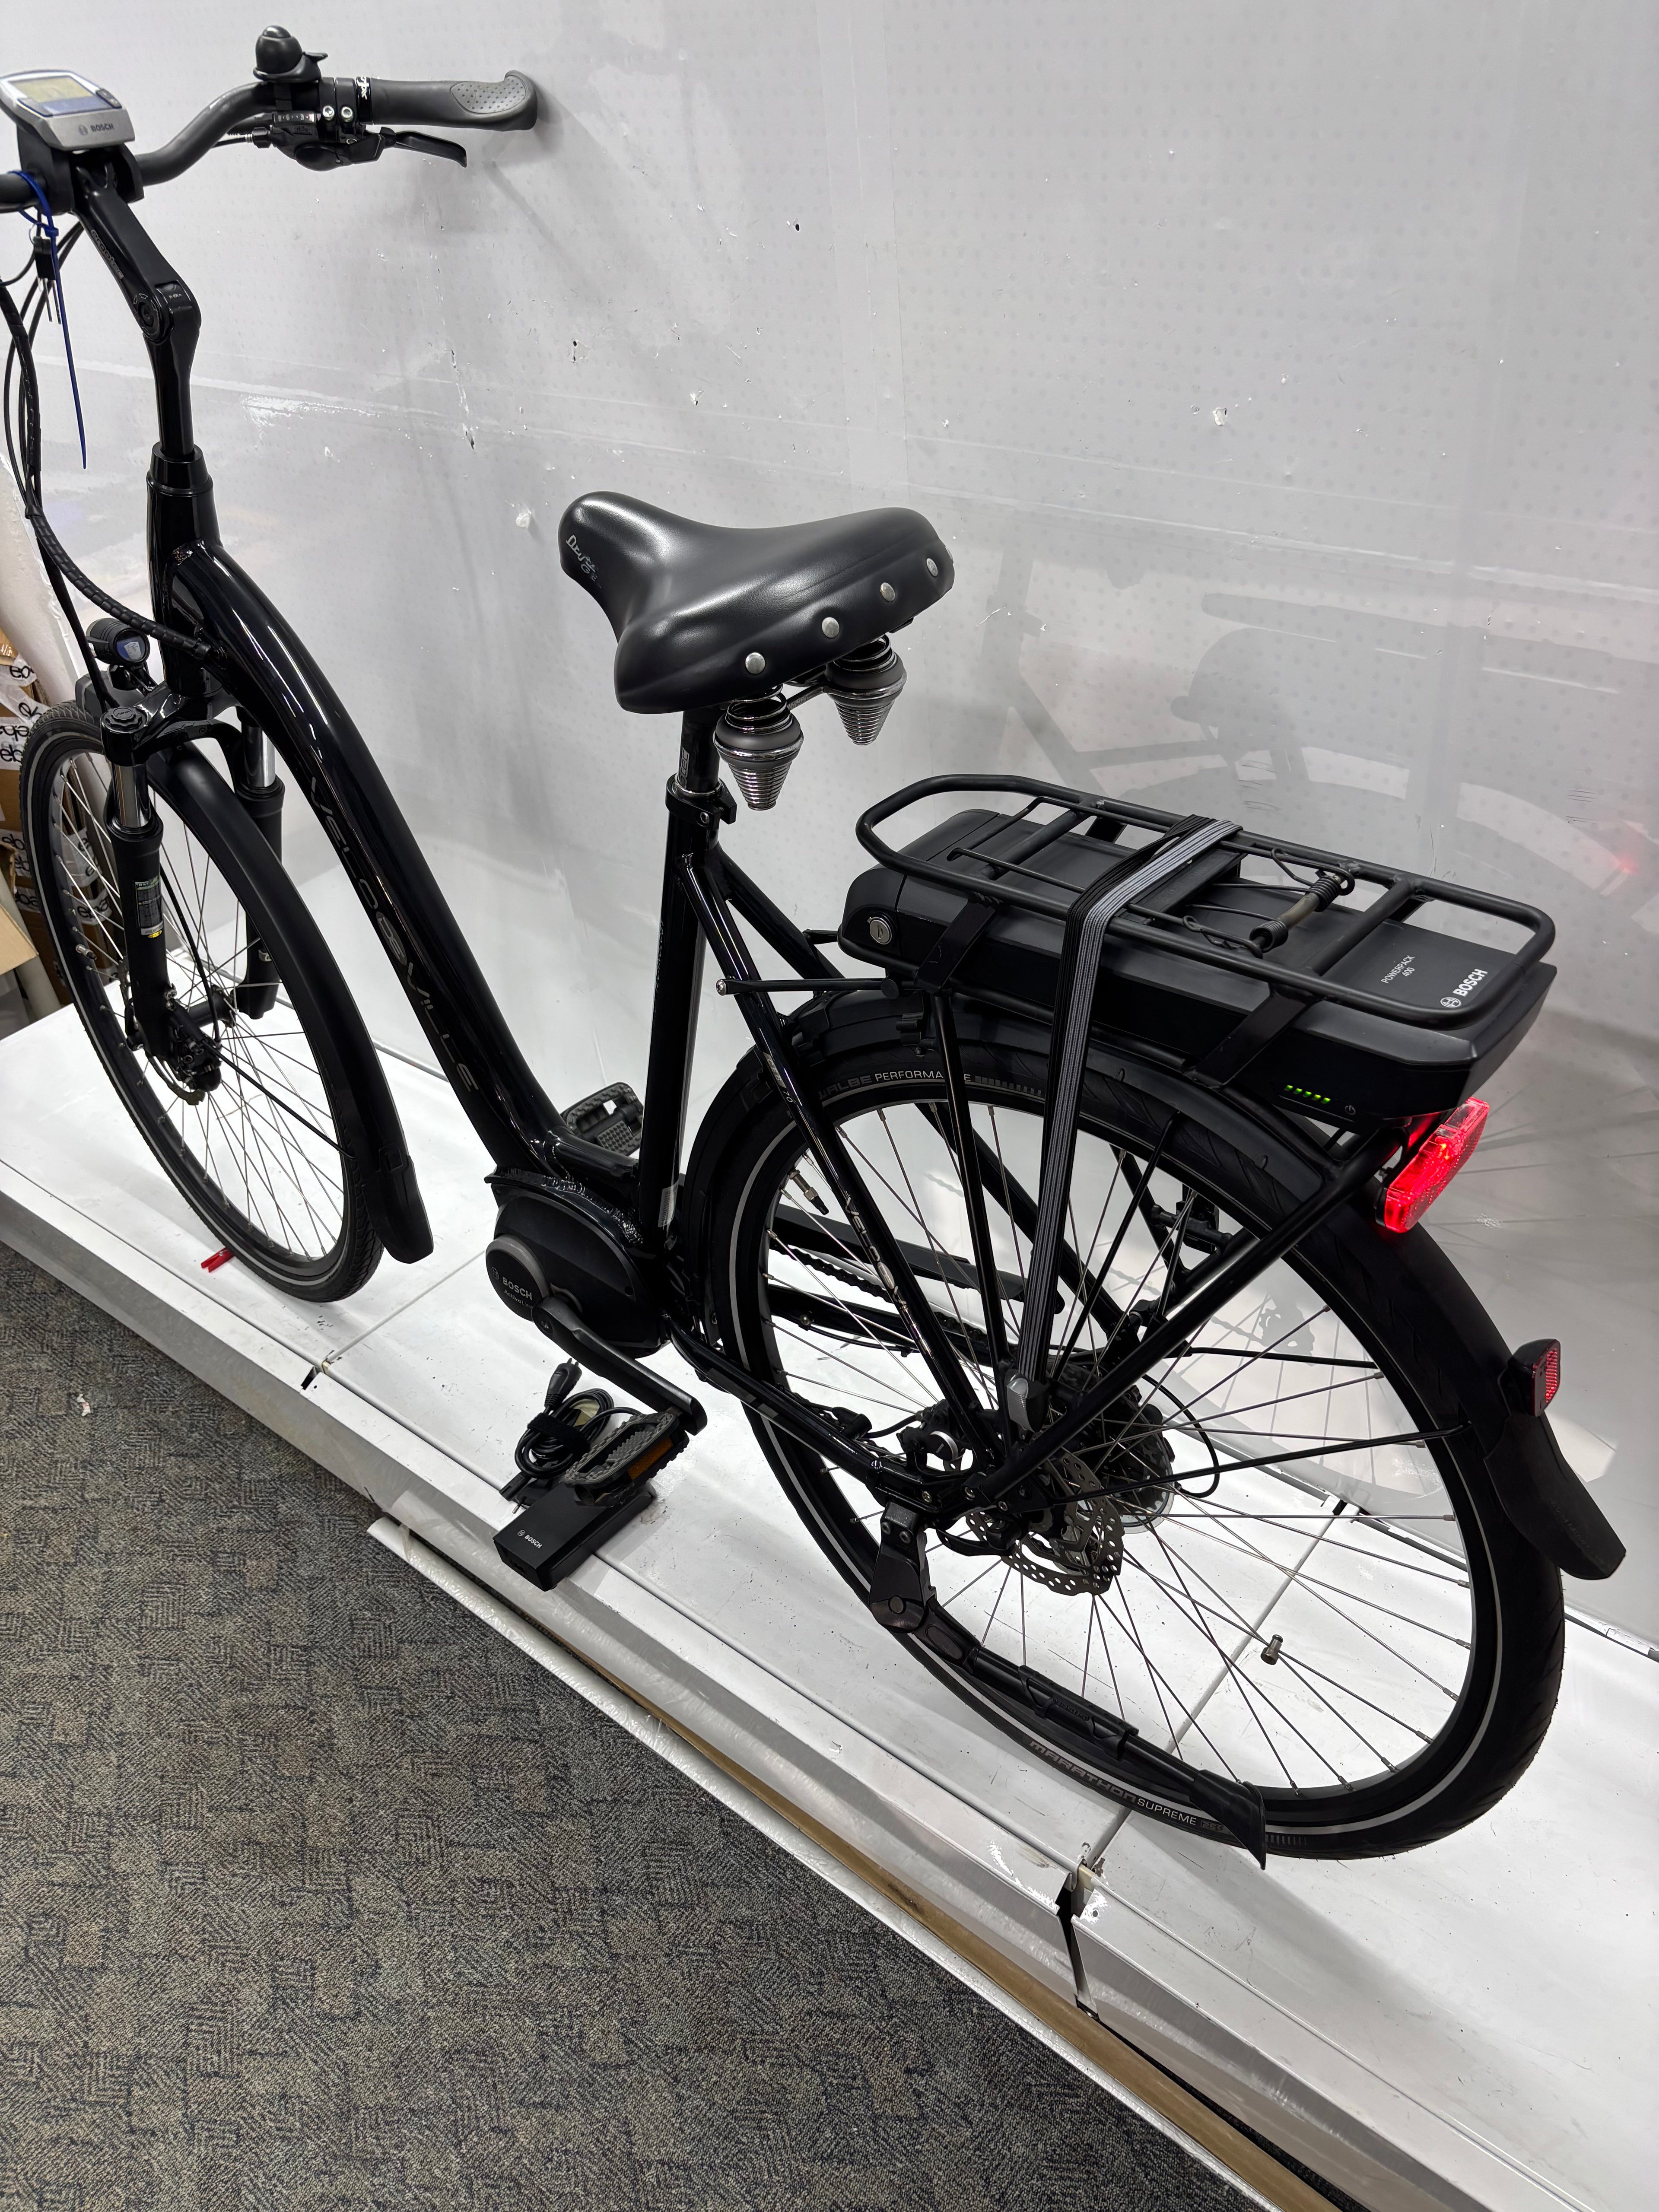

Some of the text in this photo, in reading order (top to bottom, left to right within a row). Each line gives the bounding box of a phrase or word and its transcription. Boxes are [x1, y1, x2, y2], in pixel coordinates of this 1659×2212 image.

[90, 124, 114, 132] BOSCH
[1381, 955, 1415, 983] POWERPACK
[1402, 967, 1415, 977] 400
[1452, 969, 1488, 997] BOSCH
[502, 1276, 532, 1300] BOSCH
[524, 1534, 543, 1548] BOSCH
[1137, 1798, 1197, 1825] SUPREME
